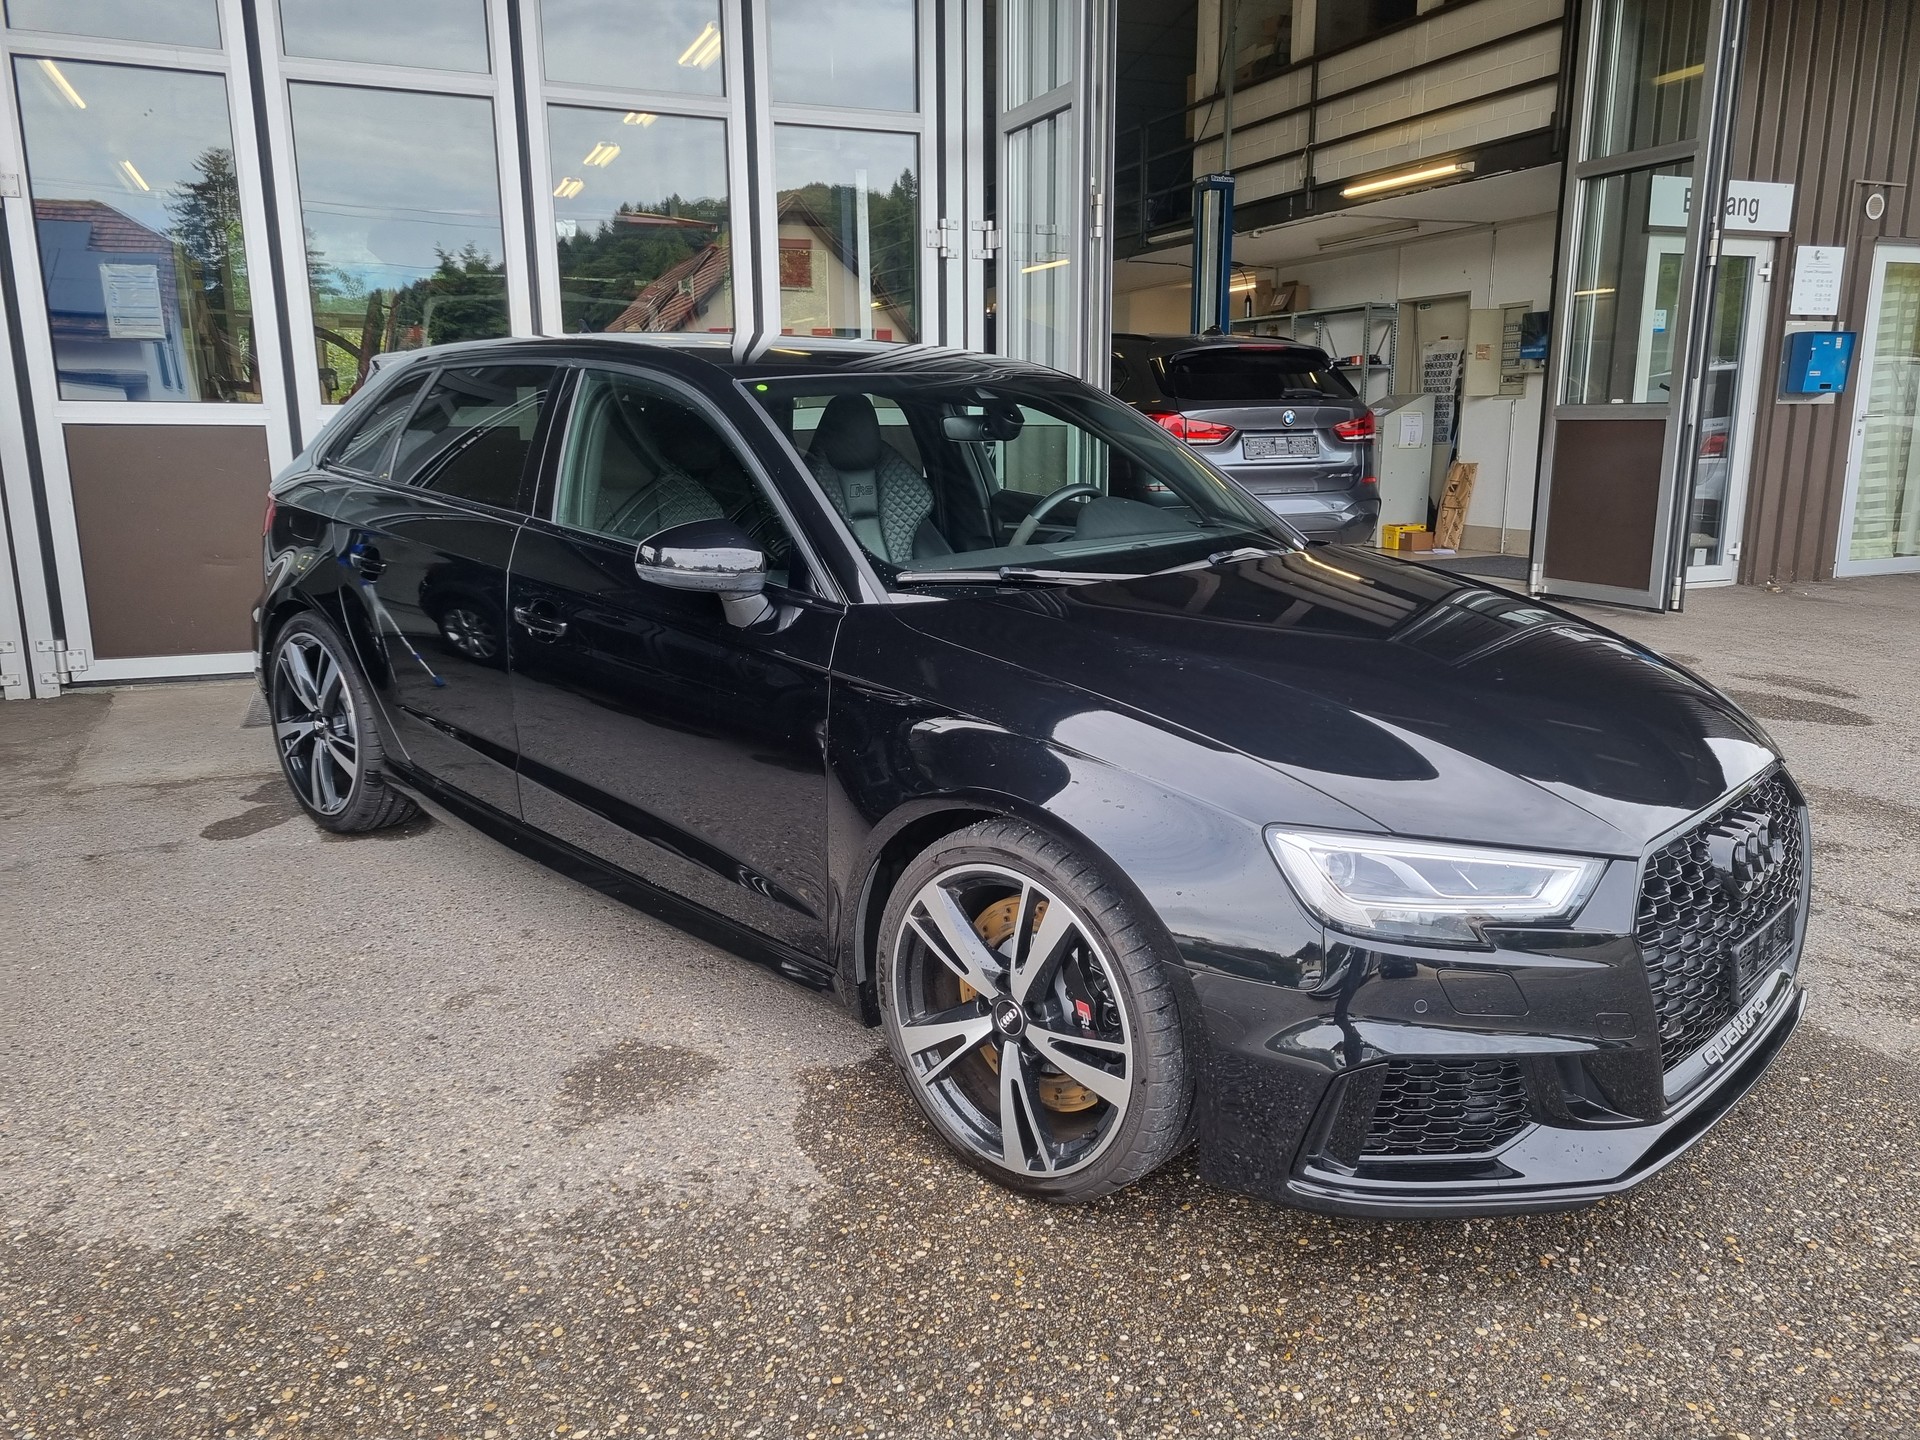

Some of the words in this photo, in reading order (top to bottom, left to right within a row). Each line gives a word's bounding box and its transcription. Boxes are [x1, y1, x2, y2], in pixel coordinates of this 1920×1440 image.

[1683, 188, 1760, 224] Eang
[852, 484, 874, 498] RS
[1703, 998, 1768, 1065] quattro
